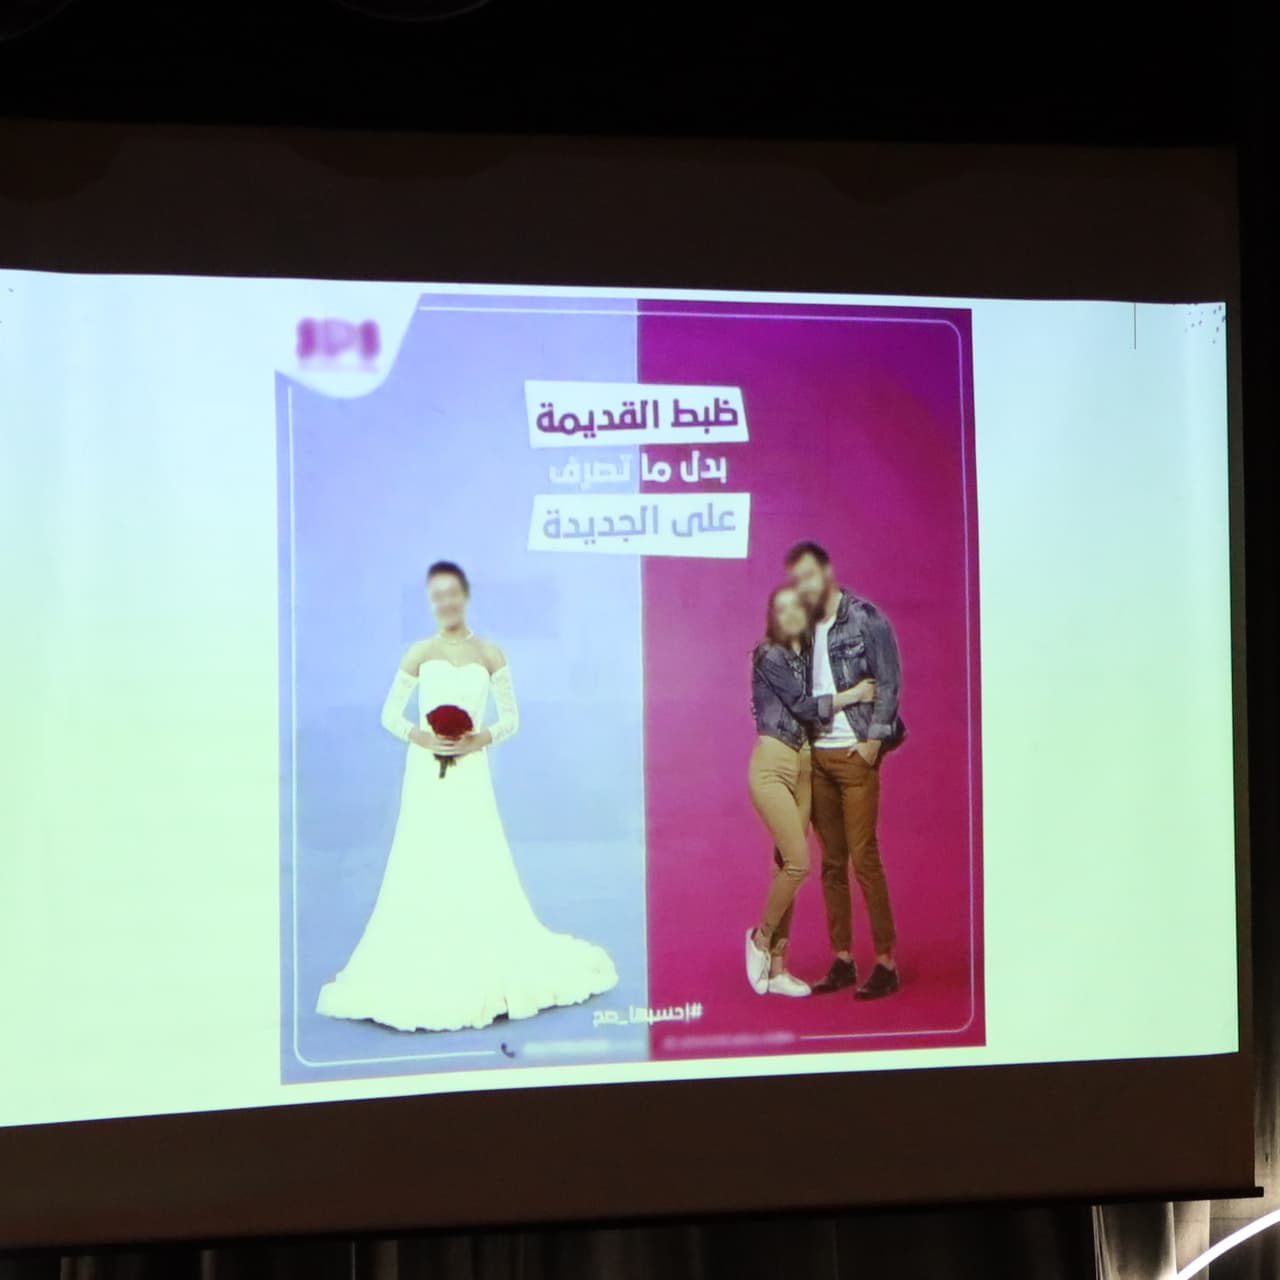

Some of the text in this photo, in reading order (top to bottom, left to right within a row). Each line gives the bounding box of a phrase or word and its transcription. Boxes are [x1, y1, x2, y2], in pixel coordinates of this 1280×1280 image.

[536, 397, 739, 439] ظبط القديمة
[548, 450, 728, 491] بدل ما تصرف
[542, 502, 736, 545] على الجديدة
